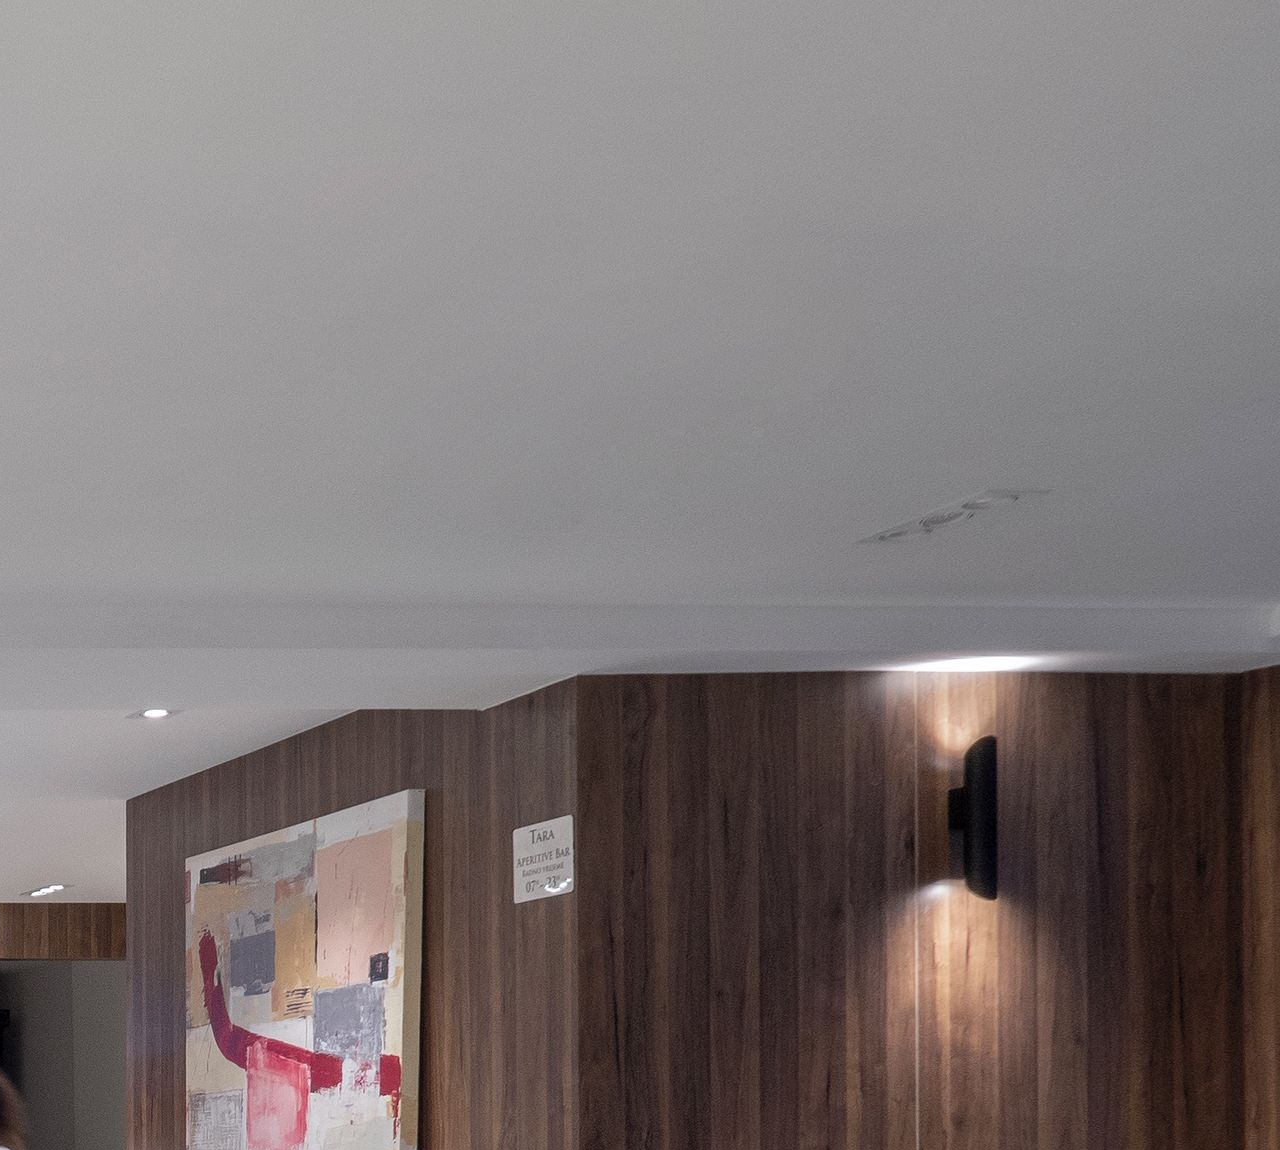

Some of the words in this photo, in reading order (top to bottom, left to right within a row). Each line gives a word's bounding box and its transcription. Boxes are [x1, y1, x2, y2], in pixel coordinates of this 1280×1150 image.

[529, 829, 555, 844] TARA
[517, 851, 553, 867] APERITIVE
[556, 847, 570, 859] BAR
